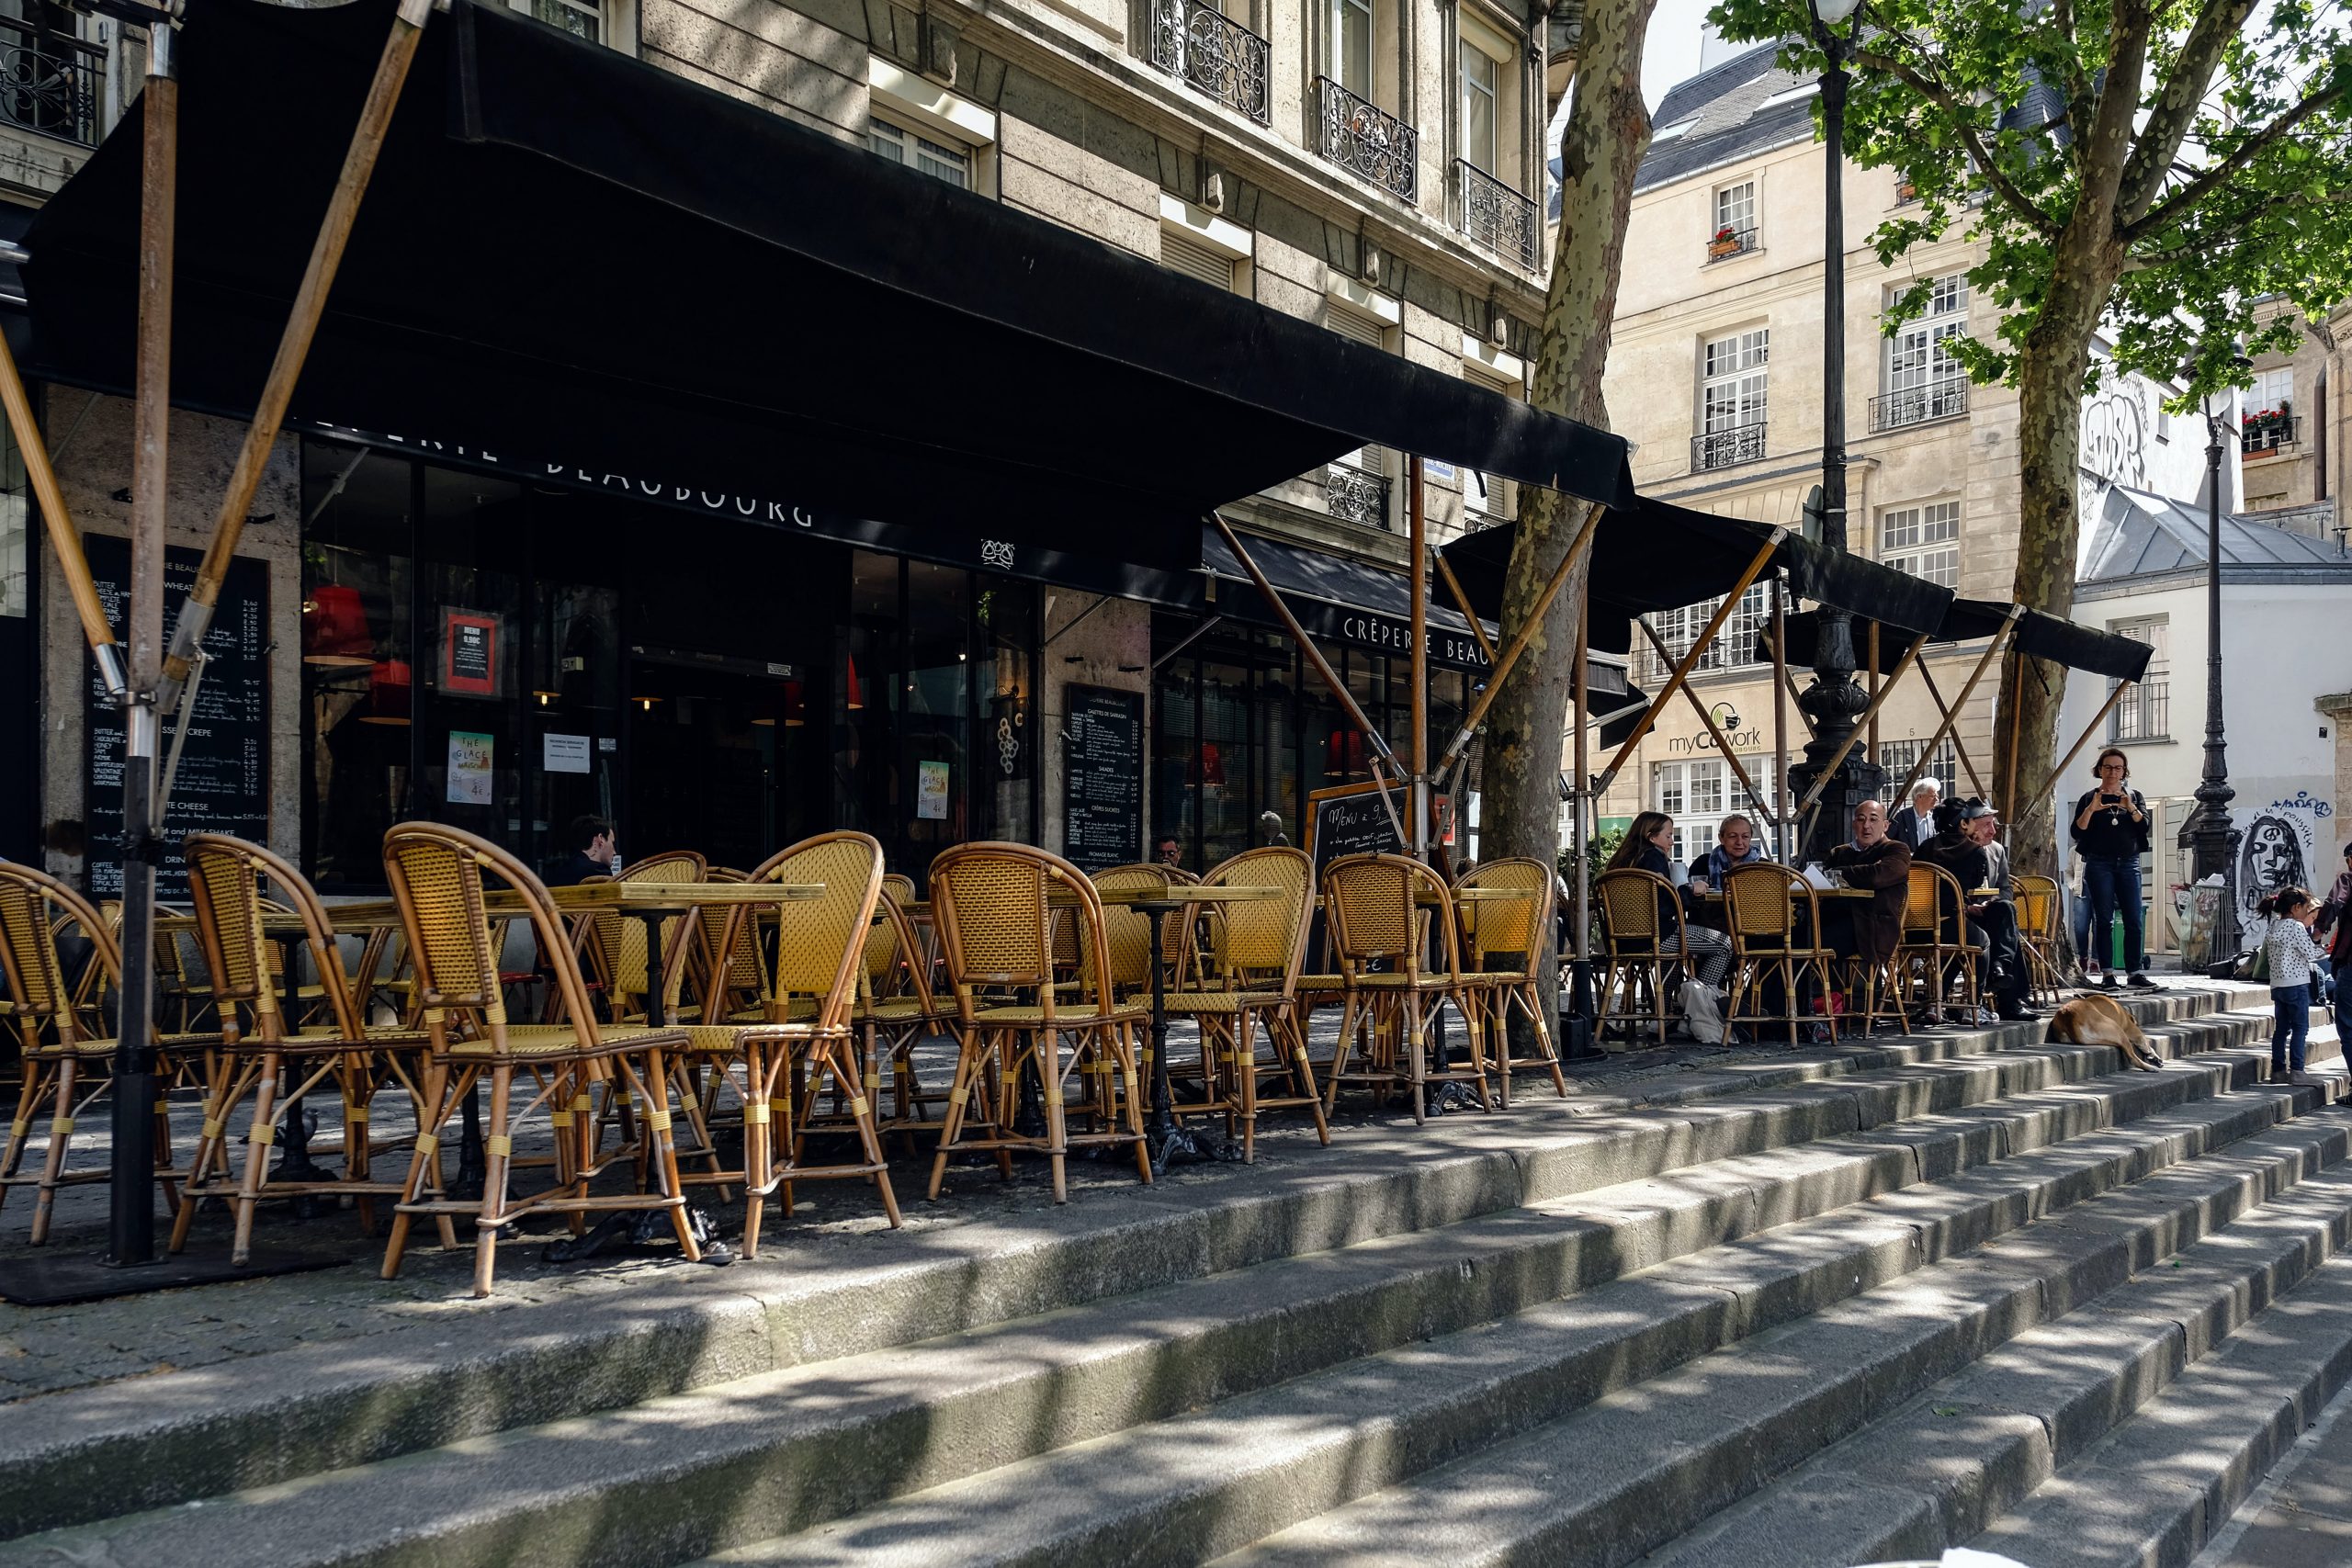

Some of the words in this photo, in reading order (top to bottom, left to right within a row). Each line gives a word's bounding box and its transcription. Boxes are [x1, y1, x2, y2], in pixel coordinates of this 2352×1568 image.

[1343, 617, 1431, 654] CRÊPERE
[1447, 639, 1488, 665] BEAU
[187, 728, 212, 738] CREPE
[1909, 728, 1916, 737] 5
[177, 802, 209, 811] CHEESE
[1329, 806, 1358, 832] MENU
[170, 828, 187, 836] and
